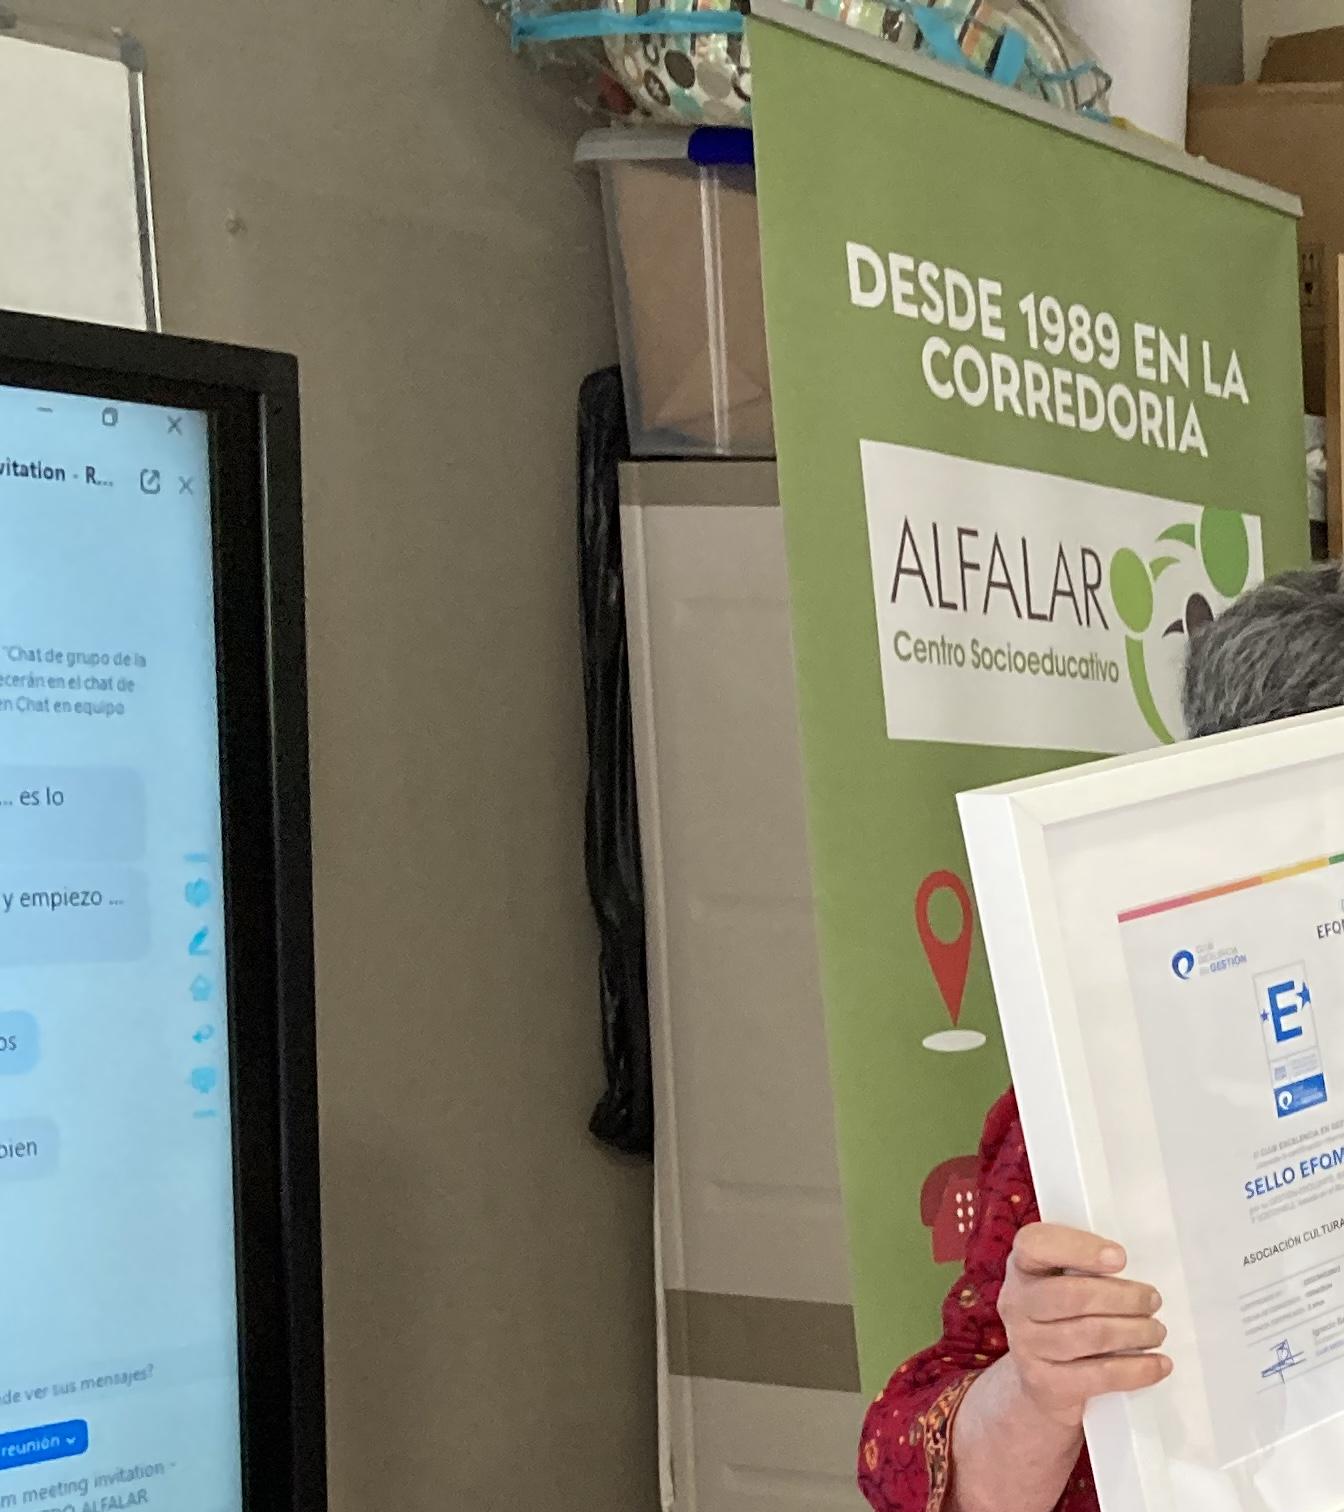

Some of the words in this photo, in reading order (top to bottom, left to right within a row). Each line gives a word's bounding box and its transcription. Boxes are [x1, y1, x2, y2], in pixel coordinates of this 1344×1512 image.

[846, 240, 1006, 342] DESDE
[1019, 292, 1120, 369] 1989
[1135, 322, 1190, 388] EN
[1202, 339, 1249, 403] LA
[921, 335, 1208, 458] CORREDORIA
[890, 516, 1110, 631] ALFALAR
[45, 648, 63, 664] de
[66, 652, 110, 668] grupo
[113, 651, 131, 667] de
[893, 629, 965, 668] Centro
[970, 636, 1120, 684] Socioeducativo
[84, 675, 113, 691] chat
[117, 677, 135, 693] de
[16, 695, 50, 713] Chat
[19, 789, 40, 807] es
[46, 786, 65, 807] lo
[2, 891, 14, 913] y
[20, 885, 103, 911] empiezo
[1244, 1165, 1297, 1200] SELLO
[24, 1386, 48, 1401] ver
[52, 1381, 77, 1397] sus
[22, 1477, 89, 1505] meeting
[94, 1462, 165, 1488] invitation
